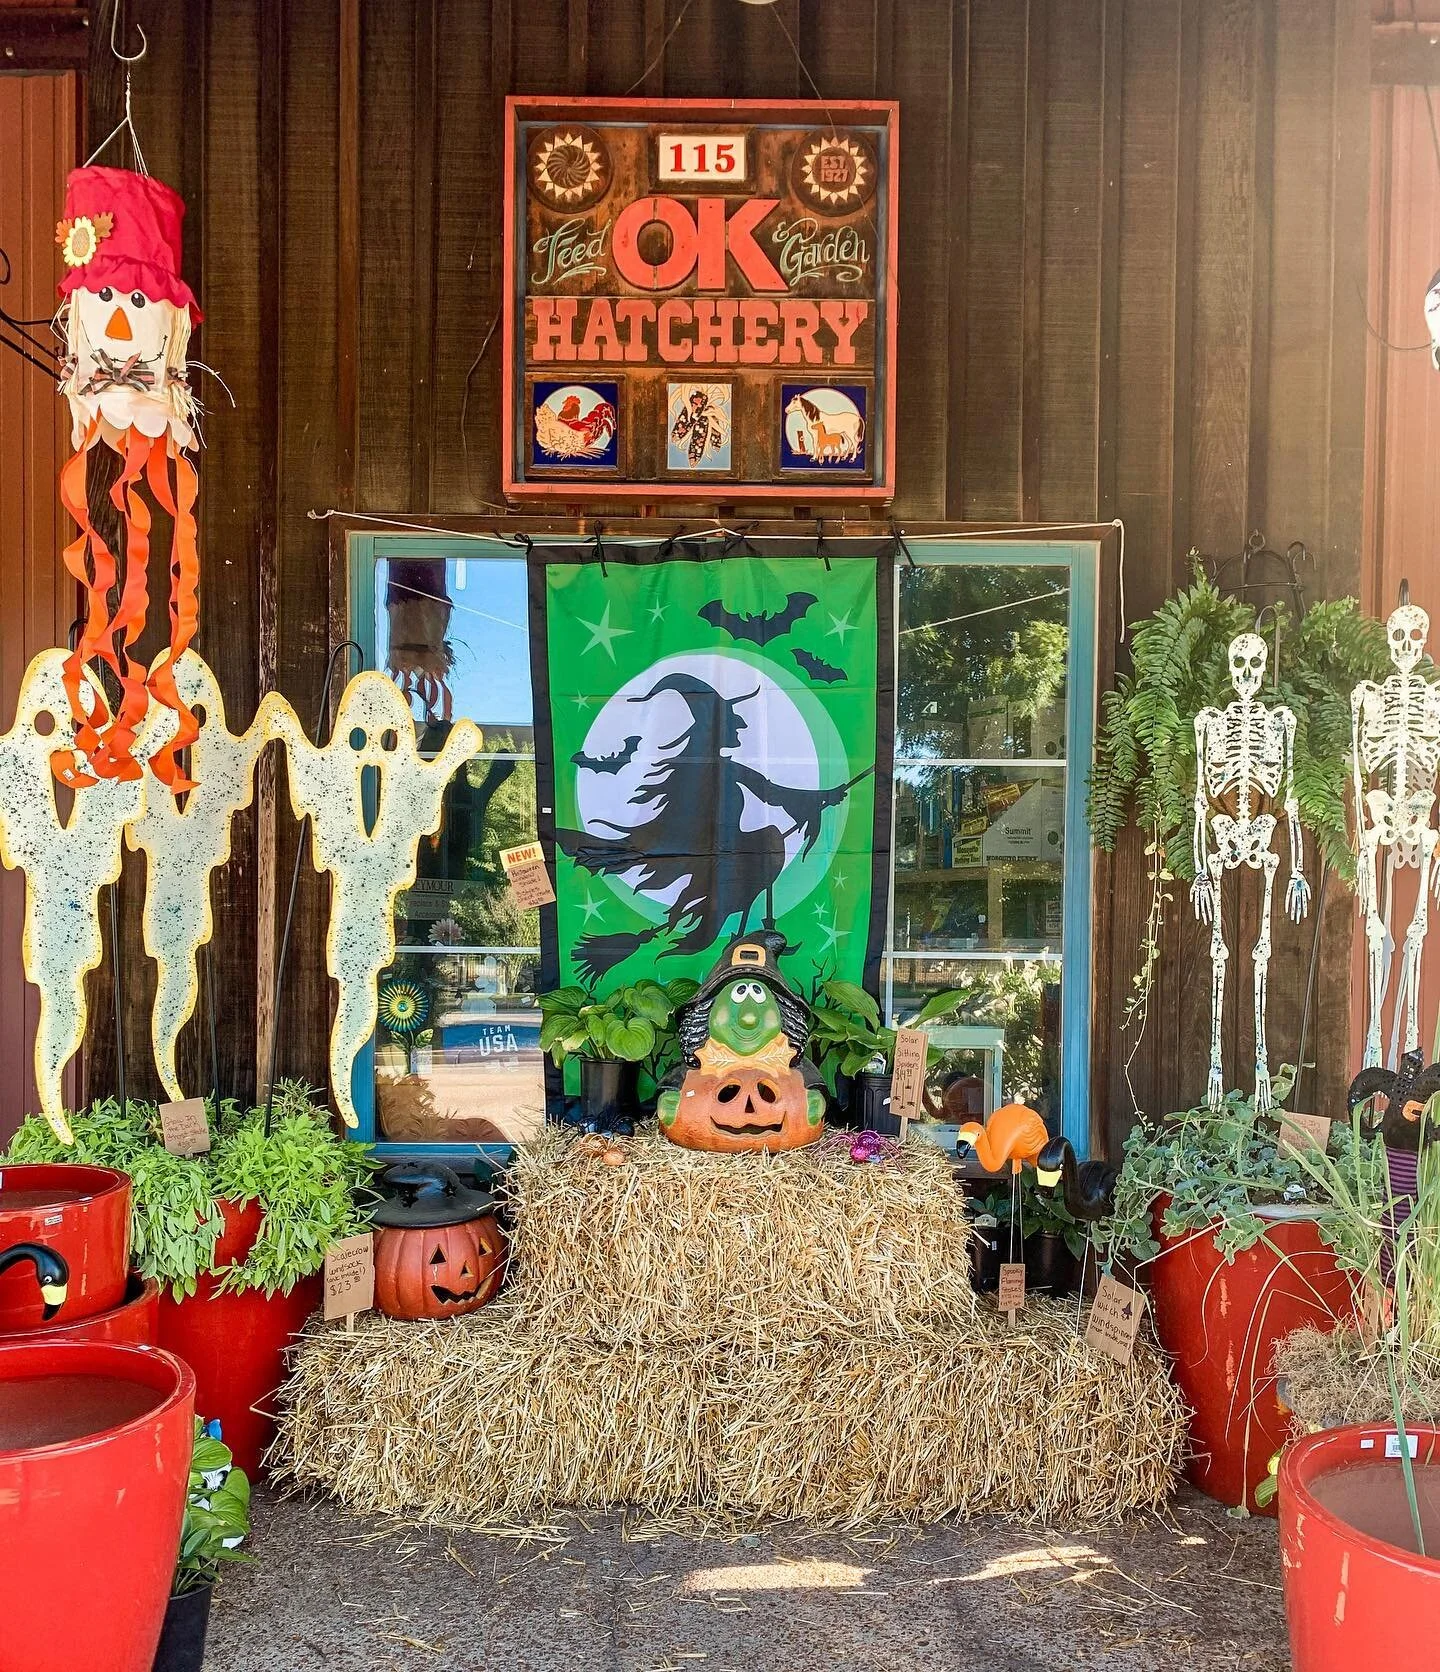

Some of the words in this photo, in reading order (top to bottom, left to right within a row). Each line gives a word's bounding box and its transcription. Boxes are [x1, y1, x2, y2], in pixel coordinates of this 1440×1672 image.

[669, 143, 736, 173] 115
[820, 168, 849, 182] 1927
[531, 217, 612, 285] Feed
[612, 196, 789, 292] OK
[779, 218, 870, 286] Garden
[532, 300, 868, 364] HATCHERY
[506, 847, 537, 864] NEW!
[482, 1024, 511, 1036] TEAM
[900, 1034, 919, 1044] Solar
[479, 1033, 519, 1057] USA
[1102, 1285, 1122, 1304] Solar
